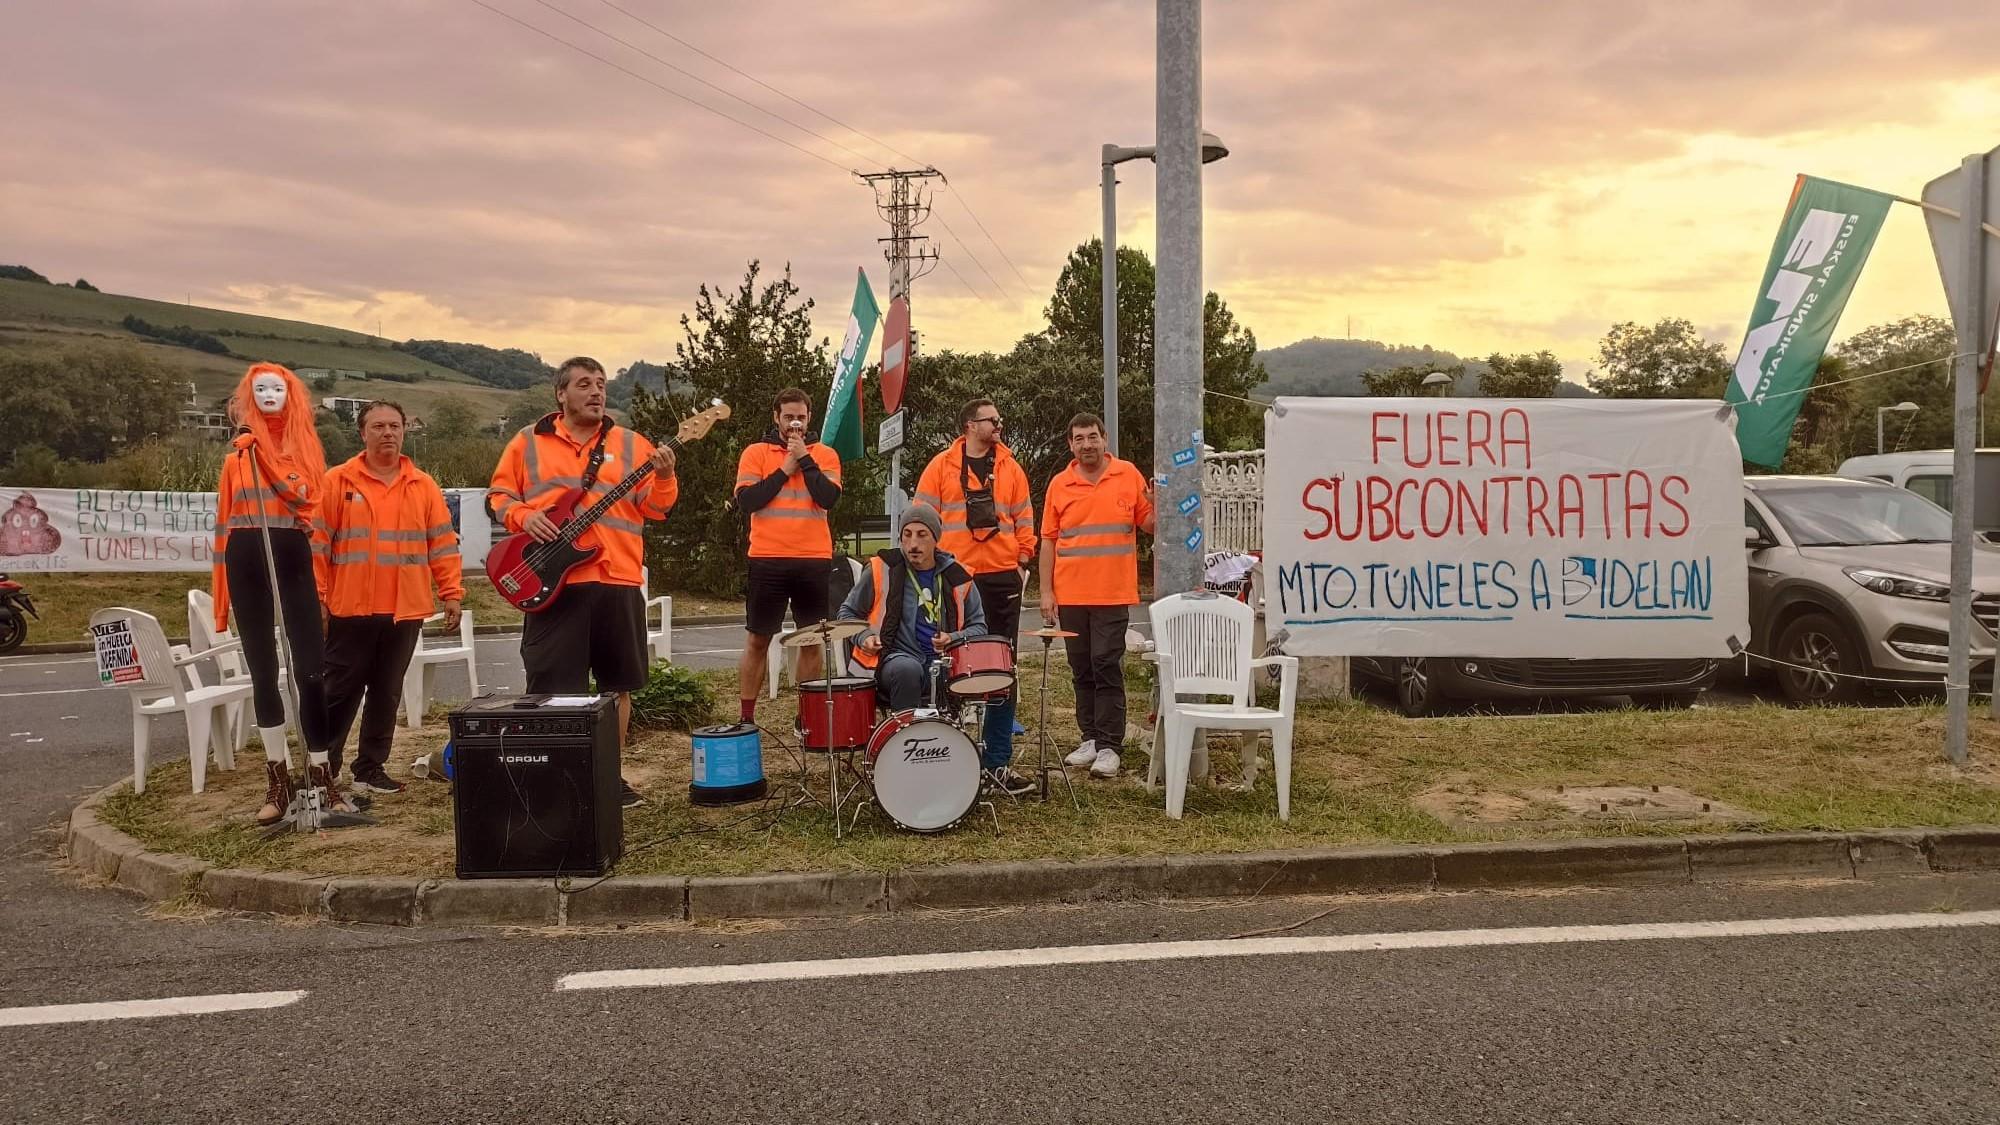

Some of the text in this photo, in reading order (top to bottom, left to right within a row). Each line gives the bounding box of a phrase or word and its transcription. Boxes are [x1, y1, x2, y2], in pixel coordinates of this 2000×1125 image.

[1373, 408, 1531, 469] FUERA
[1175, 450, 1193, 462] ELA
[77, 491, 219, 512] ALGO HUEL
[1181, 496, 1197, 511] ELA
[1303, 470, 1691, 542] SUBCONTRATAS
[77, 512, 108, 534] EN
[121, 513, 146, 532] LA
[1531, 559, 1551, 610] A
[1562, 555, 1712, 611] BIDELAN
[498, 755, 549, 763] TORGUE
[904, 737, 951, 762] Fame
